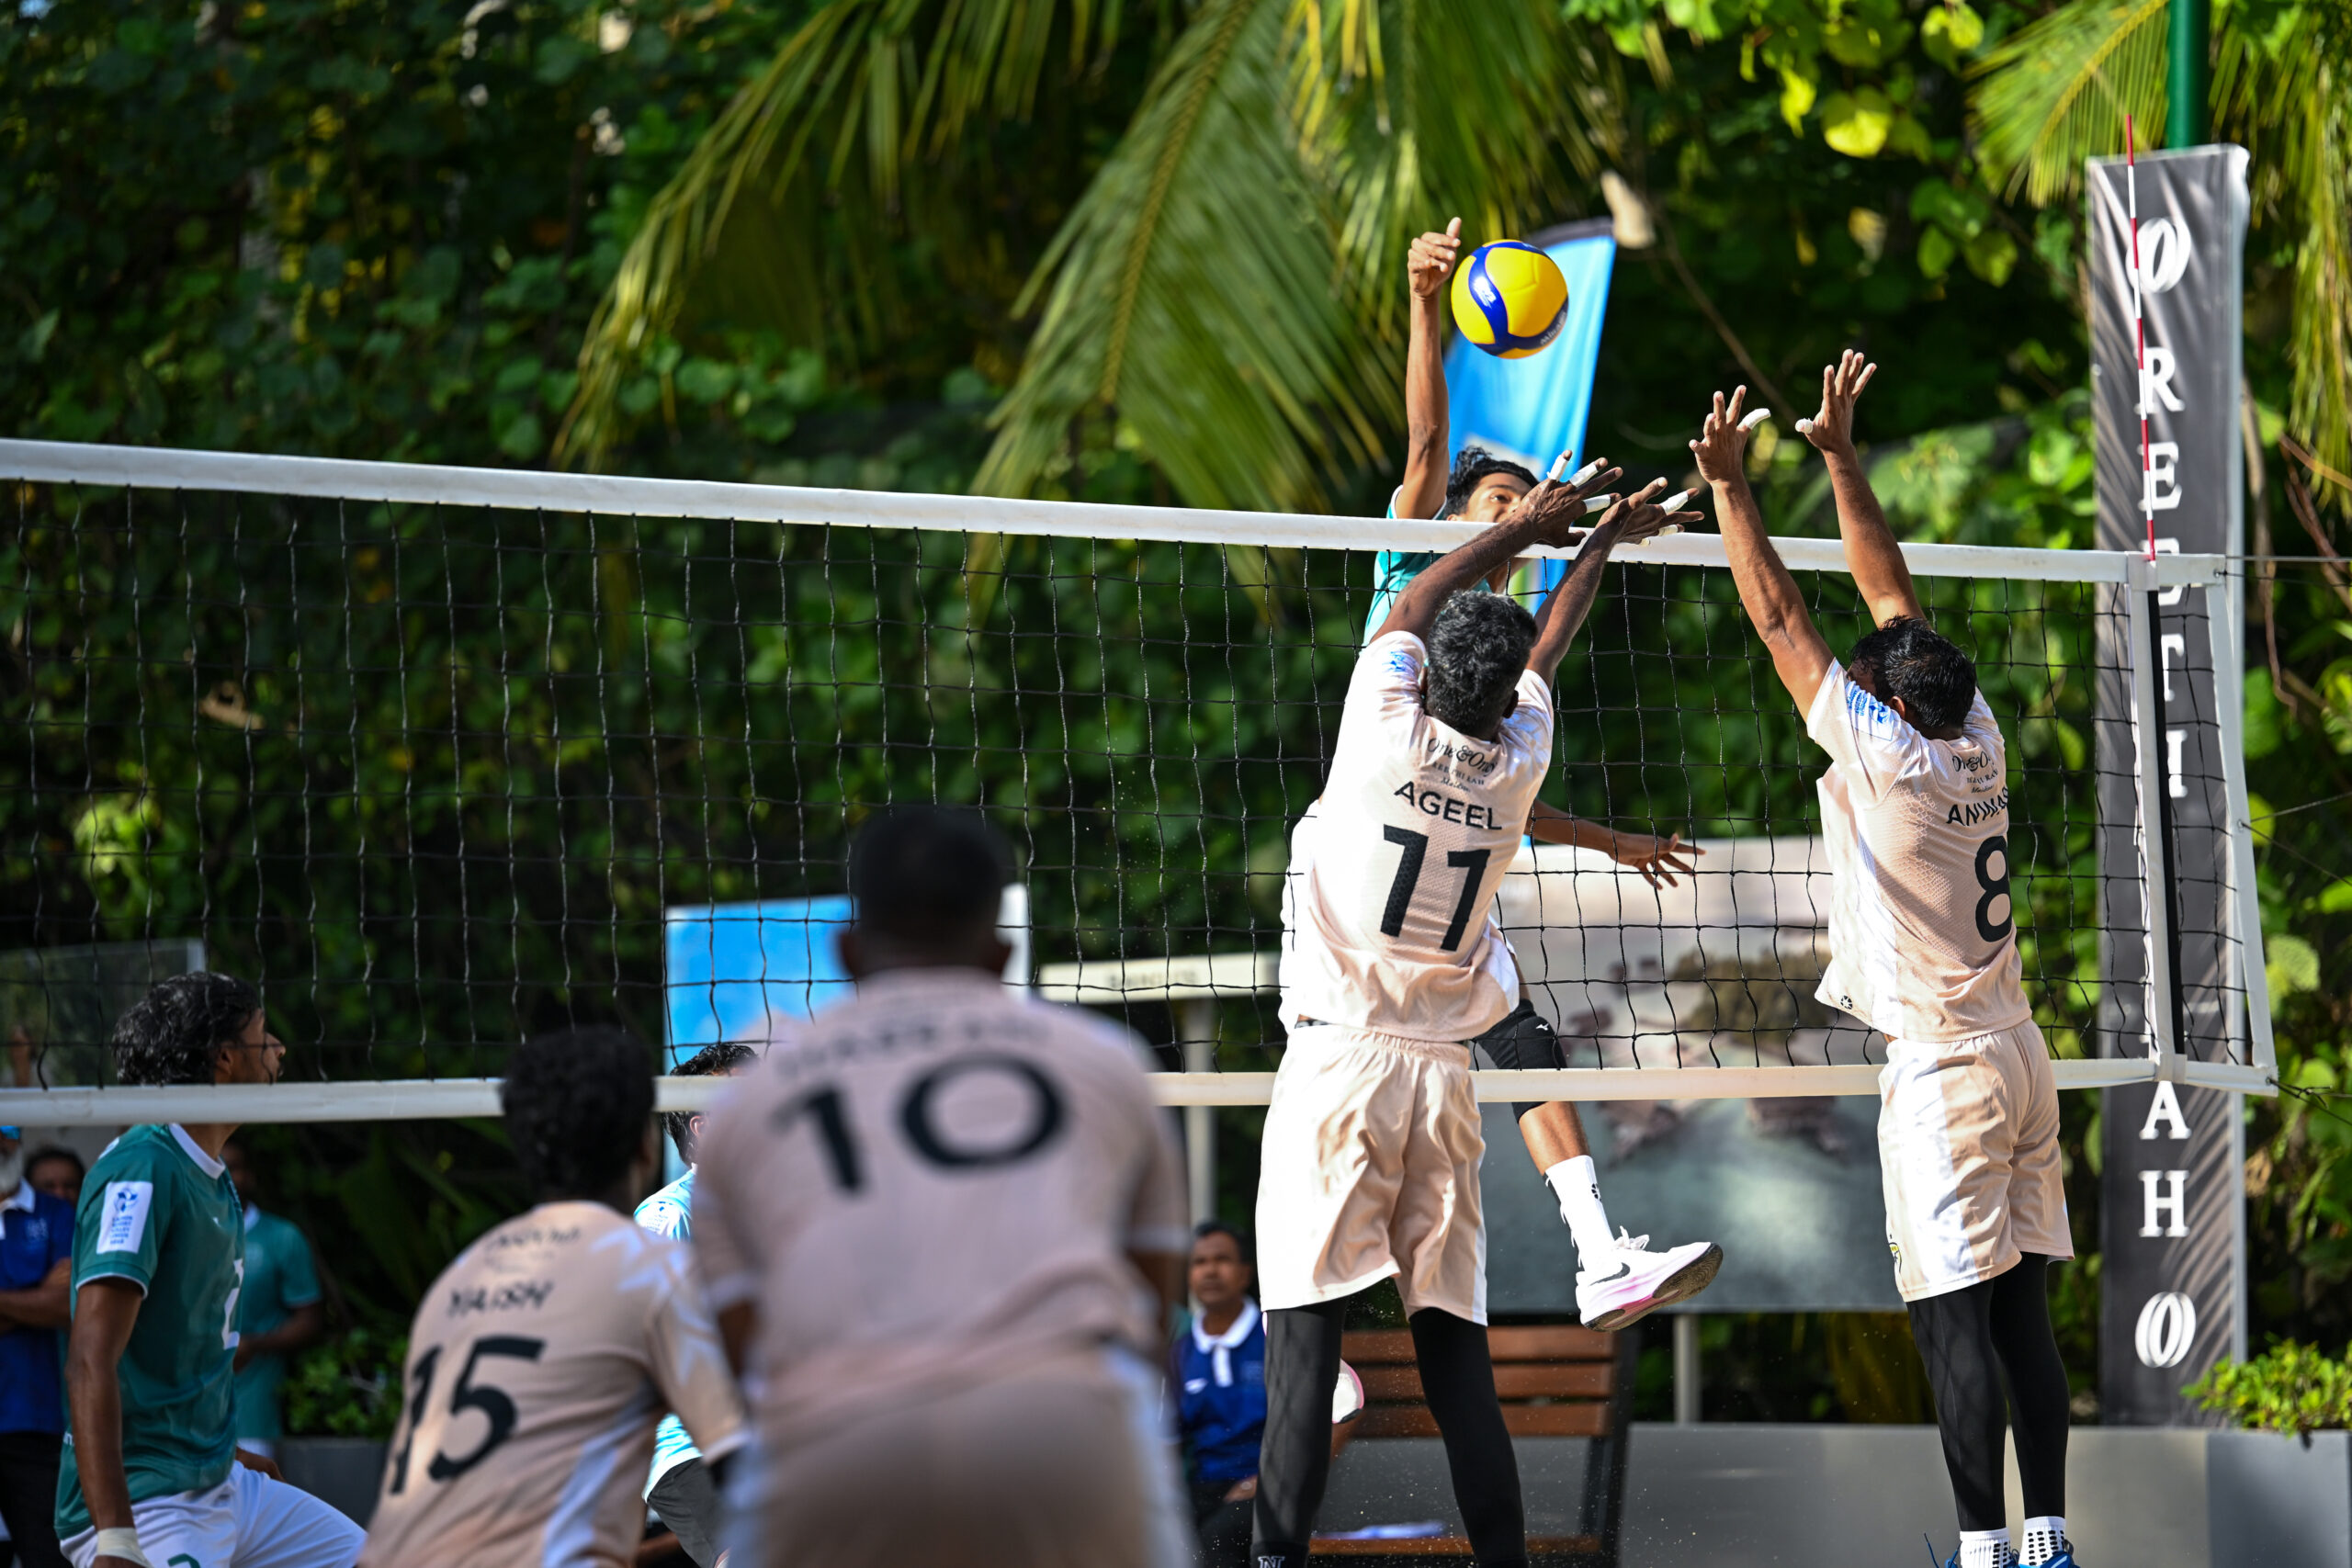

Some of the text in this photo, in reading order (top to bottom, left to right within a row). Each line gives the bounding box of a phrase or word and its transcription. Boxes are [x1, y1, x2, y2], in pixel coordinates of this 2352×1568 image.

[1394, 781, 1503, 830] AGEEL
[1380, 824, 1491, 953] 11
[1974, 835, 2013, 943] 8
[766, 1054, 1073, 1199] 10
[390, 1335, 547, 1496] 15
